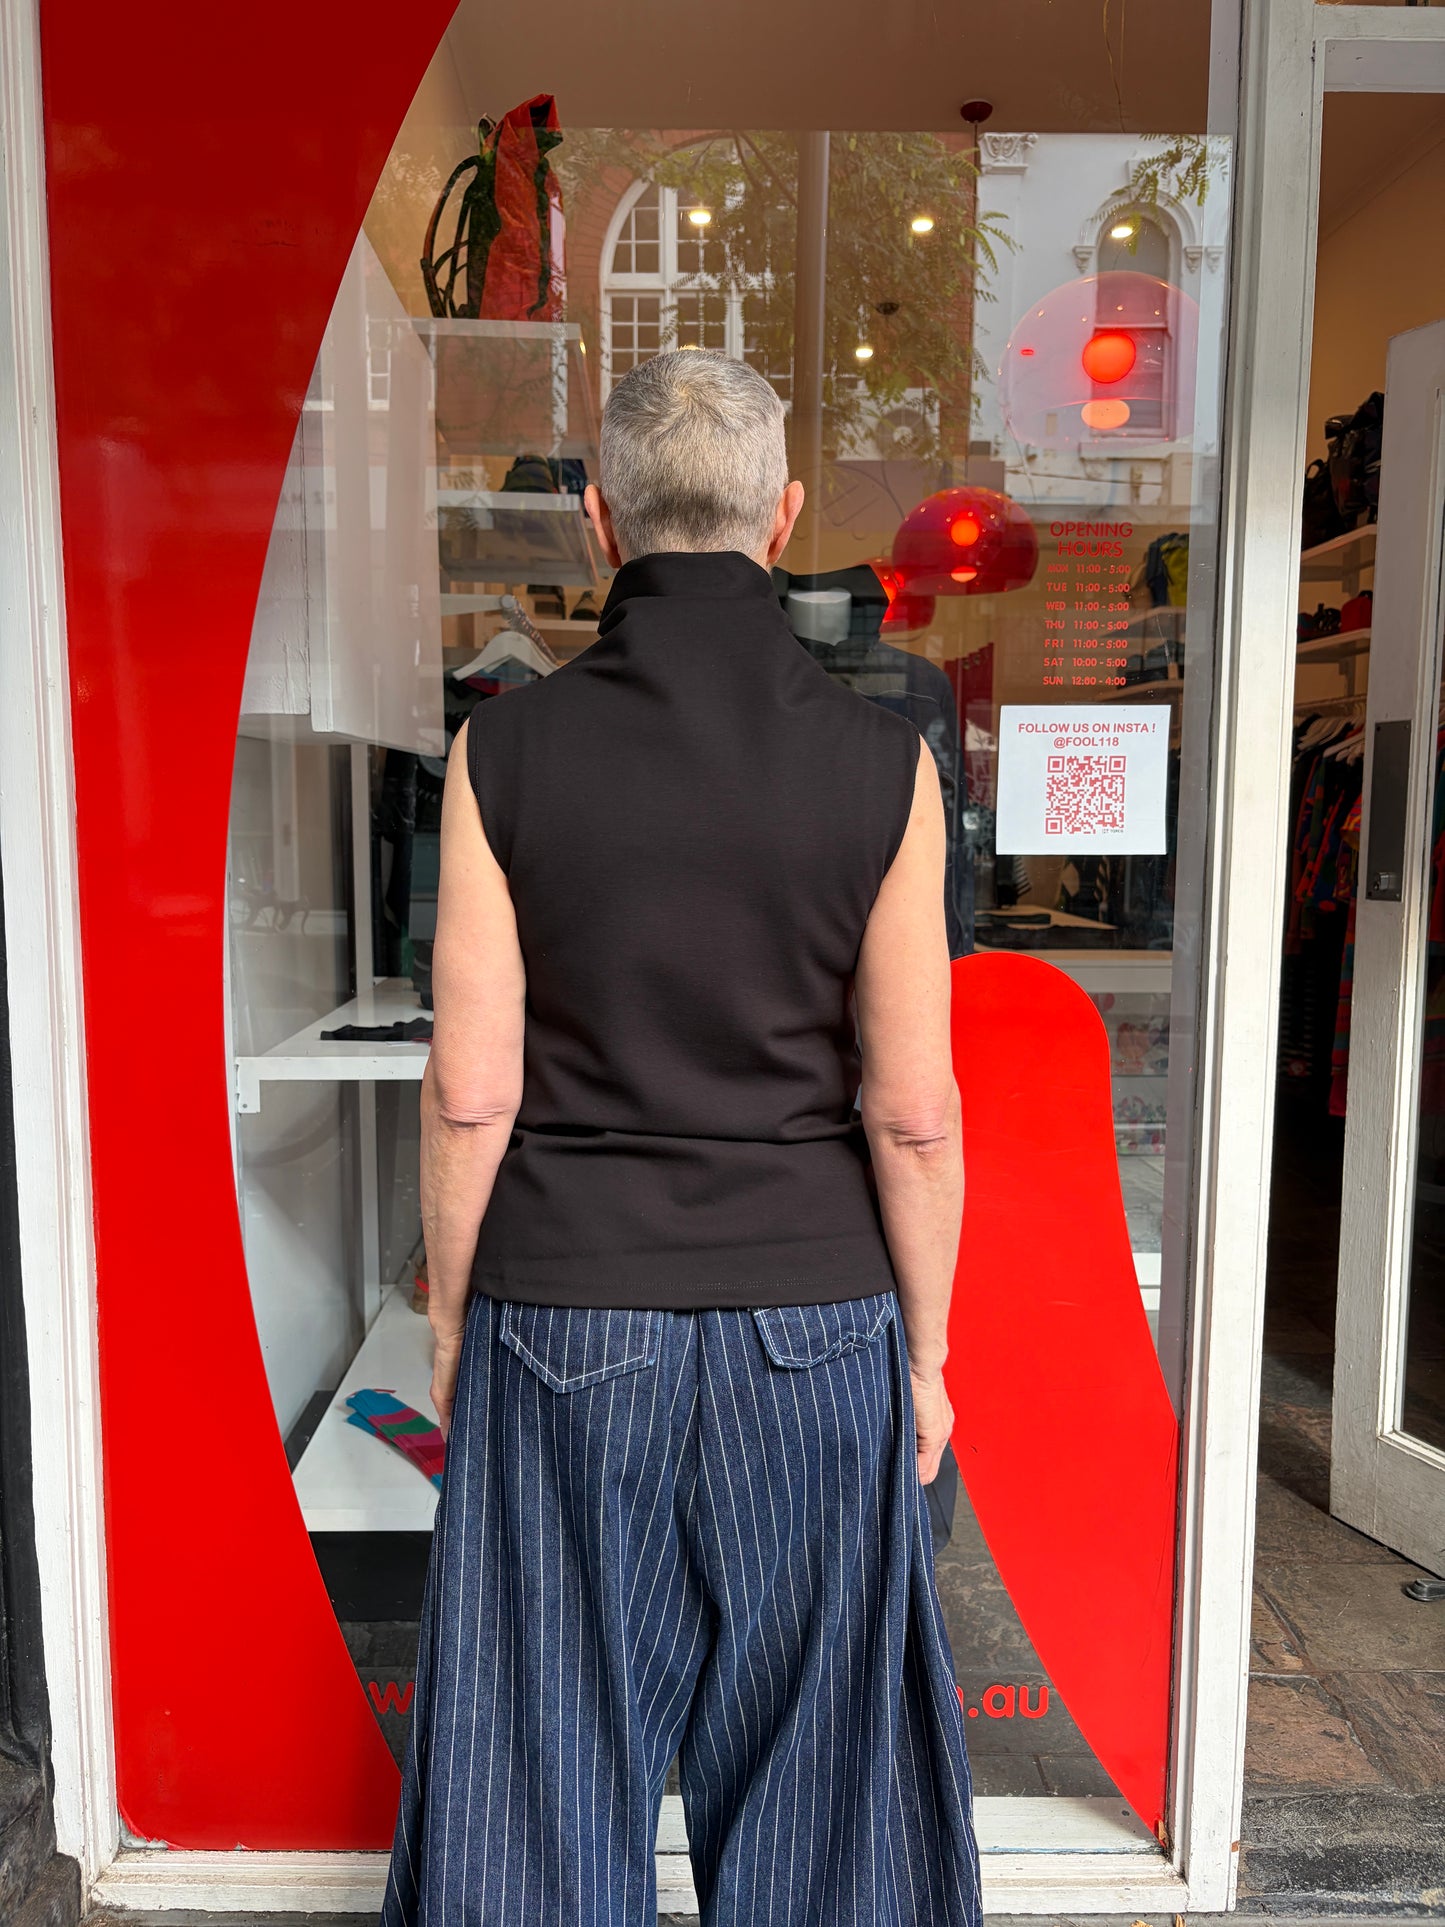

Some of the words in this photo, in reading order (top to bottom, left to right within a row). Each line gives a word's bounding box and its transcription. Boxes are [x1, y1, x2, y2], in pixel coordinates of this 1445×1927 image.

[1050, 521, 1133, 538] OPENING
[1058, 540, 1124, 557] HOURS
[1047, 564, 1069, 573] MON
[1076, 564, 1101, 573] 11:00
[1109, 565, 1131, 574] 5:00
[1047, 582, 1067, 592] TUE
[1075, 583, 1100, 592] 11:00
[1108, 583, 1130, 593] 5:00
[1046, 601, 1066, 611] WED
[1074, 601, 1099, 611] 11:00
[1108, 602, 1129, 612] 5:00
[1045, 620, 1065, 630] THU
[1074, 620, 1099, 630] 11:00
[1107, 621, 1129, 631] 5:00
[1044, 639, 1064, 648] FRI
[1073, 639, 1098, 648] 11:00
[1106, 639, 1128, 649] 5:00
[1043, 658, 1064, 667] SAT
[1072, 658, 1097, 667] 10:00
[1106, 658, 1127, 667] 5:00
[1042, 676, 1063, 685] SUN
[1105, 676, 1126, 686] 4:00
[1018, 723, 1070, 733] FOLLOW
[1072, 723, 1089, 733] US
[1092, 723, 1110, 733] ON
[1113, 723, 1149, 733] INSTA
[1053, 737, 1119, 749] @FOOL118
